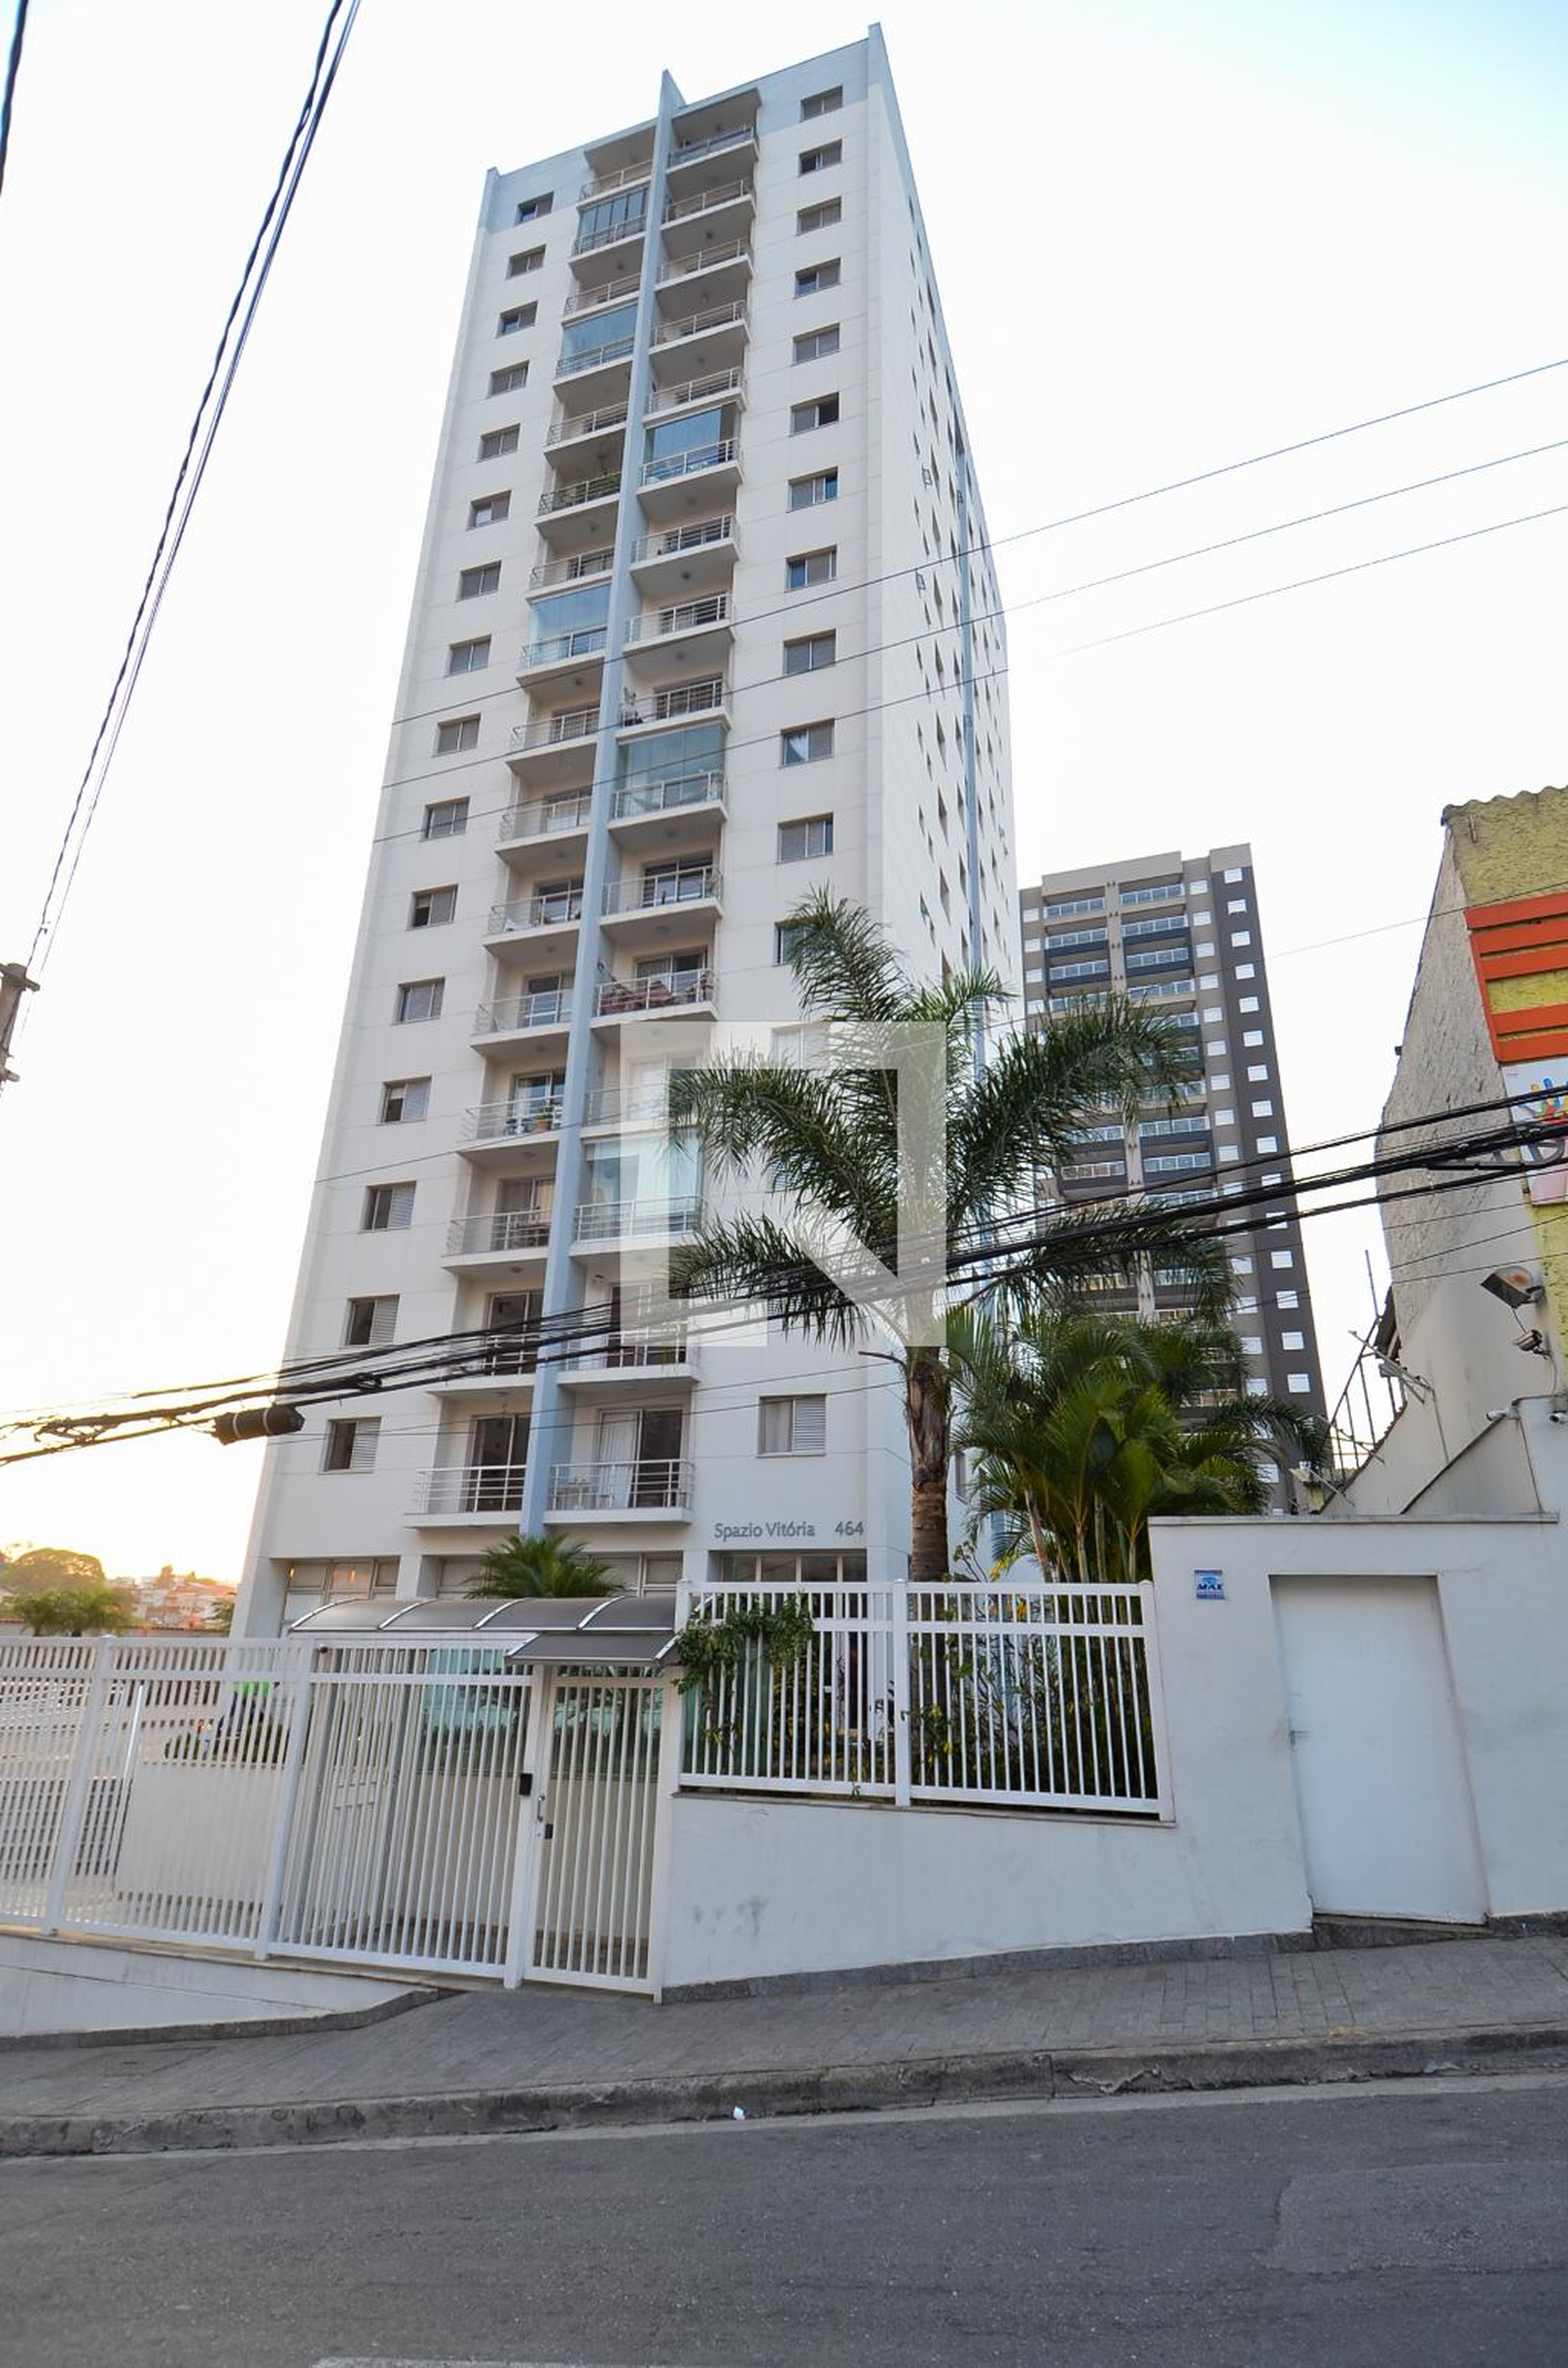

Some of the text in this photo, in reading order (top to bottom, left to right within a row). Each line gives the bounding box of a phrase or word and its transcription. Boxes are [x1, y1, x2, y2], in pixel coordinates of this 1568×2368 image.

[715, 1521, 864, 1542] Spazio Vitória 464
